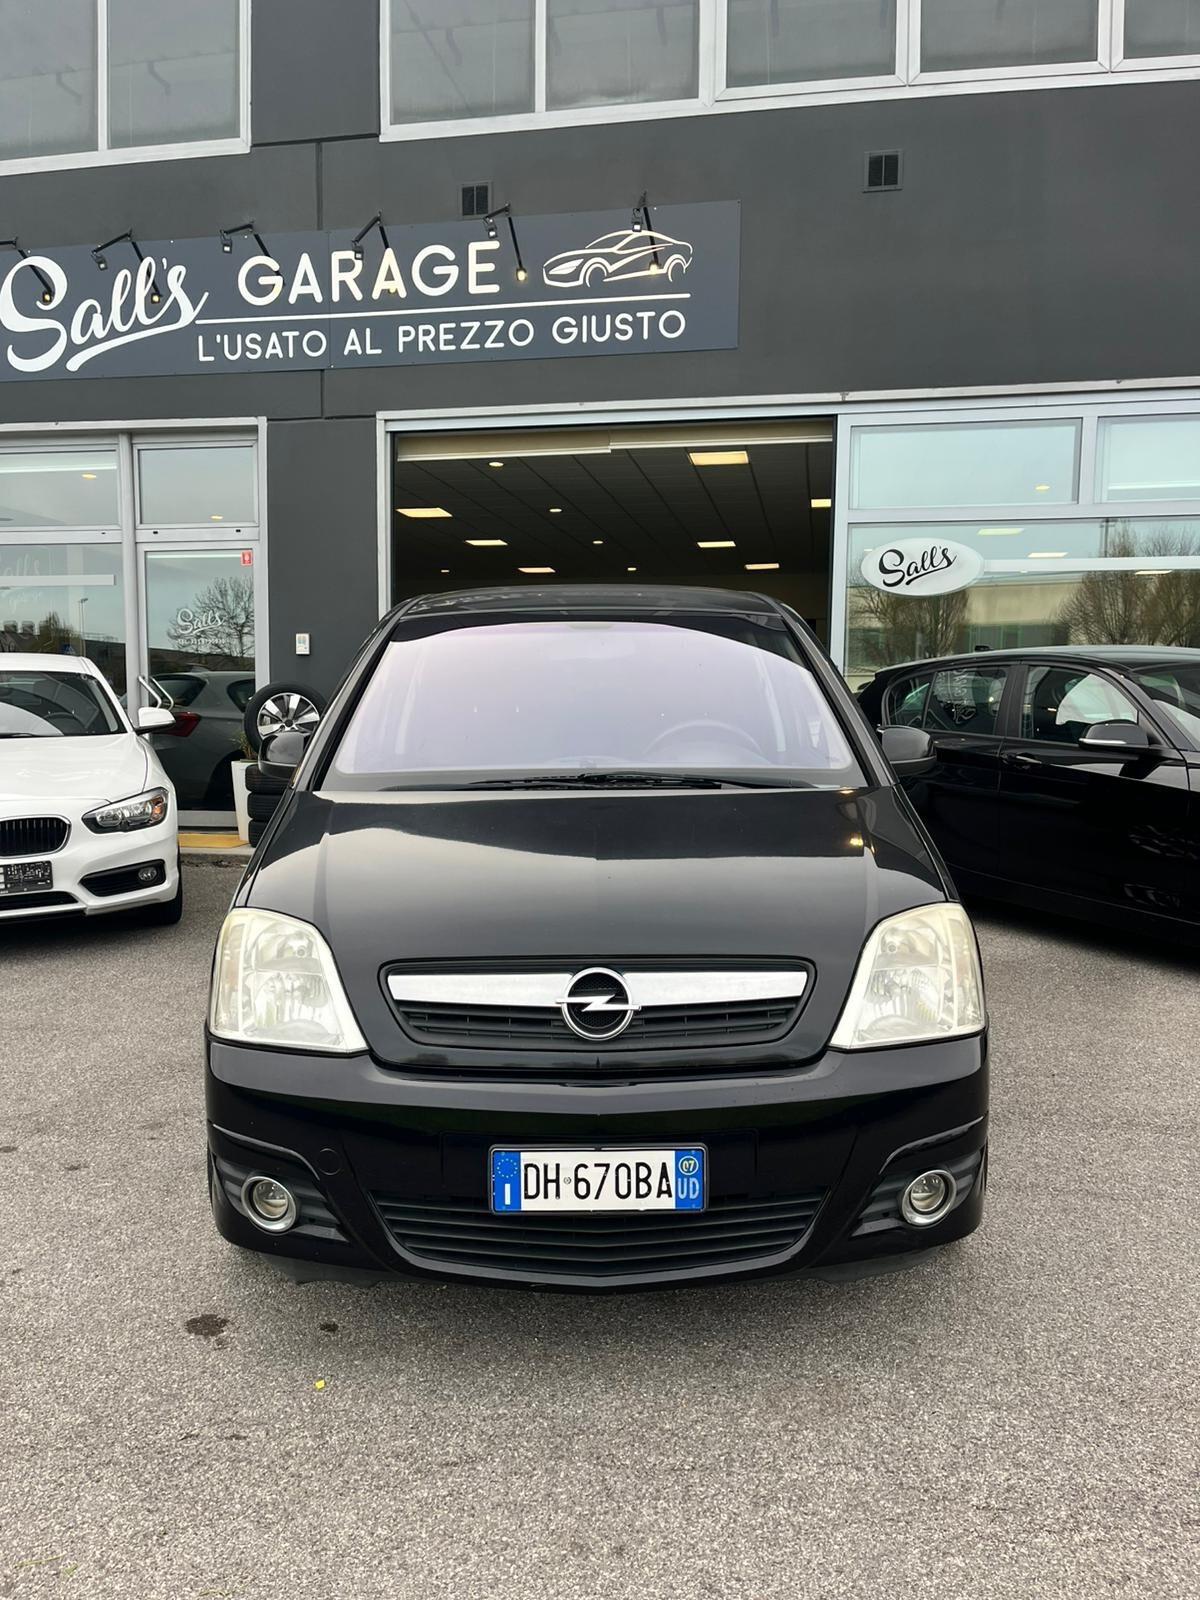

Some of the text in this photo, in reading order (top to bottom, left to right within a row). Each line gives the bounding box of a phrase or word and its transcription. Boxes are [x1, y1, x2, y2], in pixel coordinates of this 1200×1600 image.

[0, 247, 500, 372] Sall's GARAGE
[199, 310, 686, 361] L'USATO AL PREZZO GIUSTO
[879, 545, 957, 587] Sall's
[682, 1160, 695, 1172] 07
[677, 1177, 700, 1200] UD
